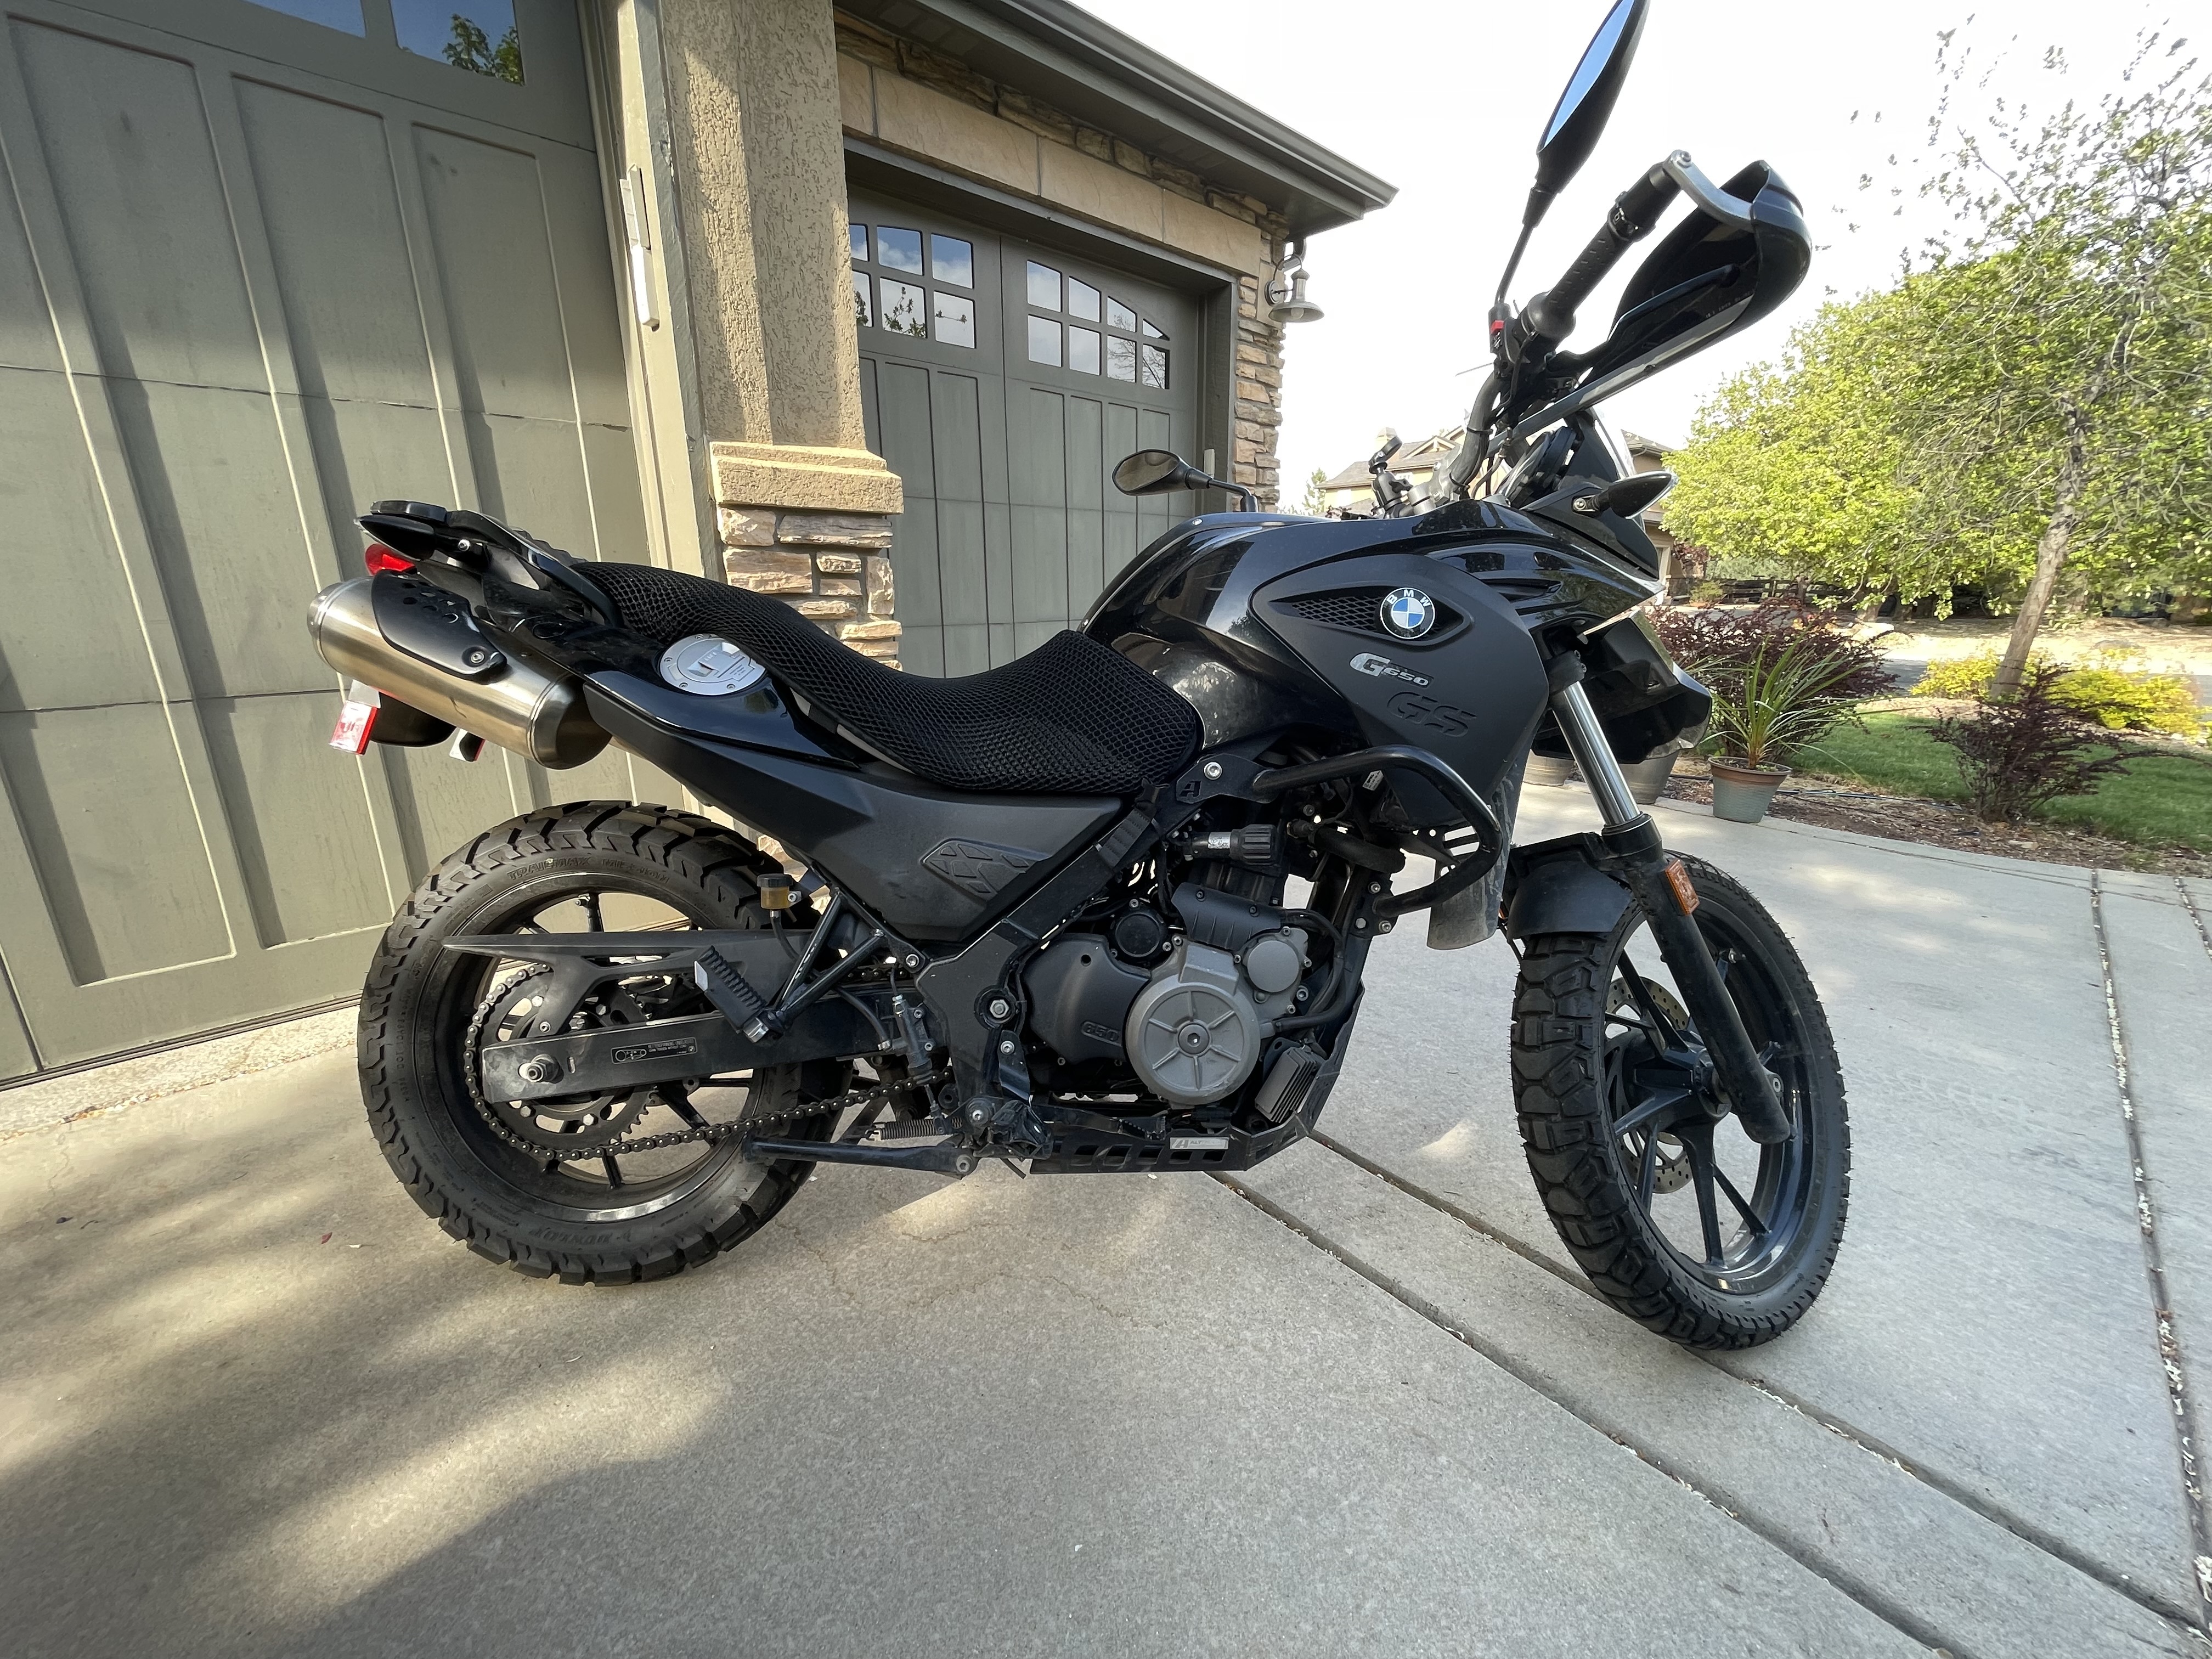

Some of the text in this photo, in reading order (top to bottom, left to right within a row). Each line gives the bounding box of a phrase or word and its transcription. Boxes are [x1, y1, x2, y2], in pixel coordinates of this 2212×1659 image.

[1386, 589, 1431, 607] BMW
[1350, 653, 1429, 687] G650
[1387, 691, 1477, 737] GS
